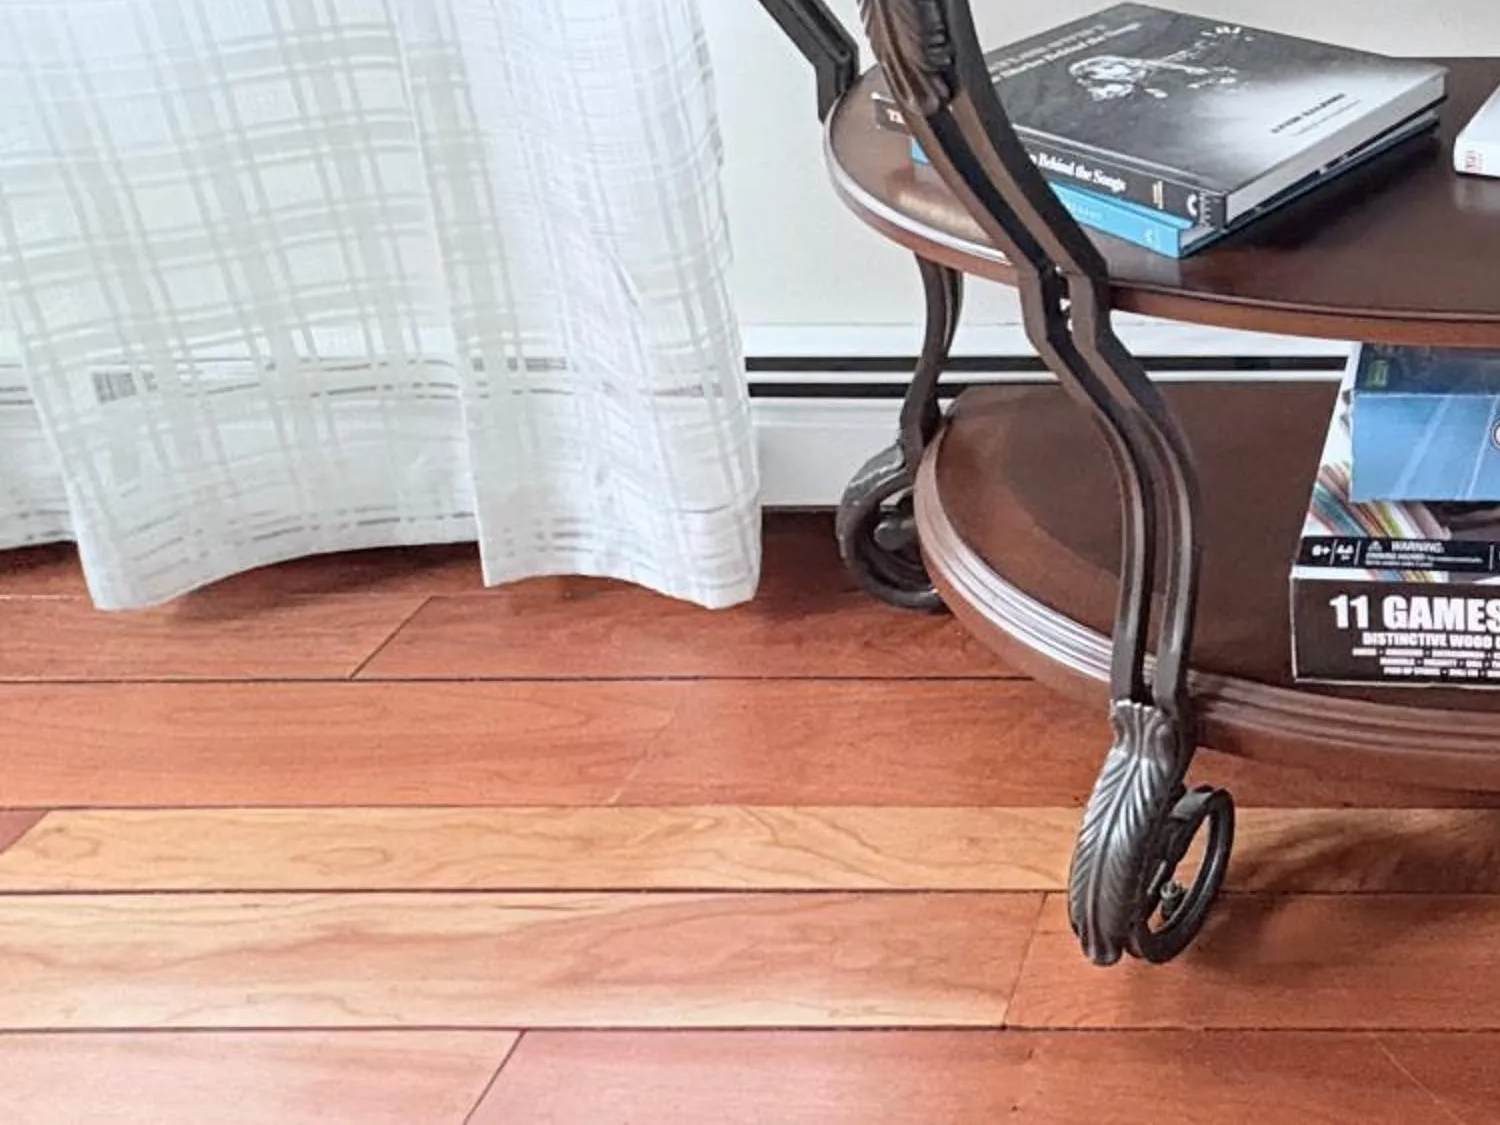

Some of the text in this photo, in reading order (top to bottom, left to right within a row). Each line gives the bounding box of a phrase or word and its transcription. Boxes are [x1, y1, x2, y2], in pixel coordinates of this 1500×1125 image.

[1039, 152, 1075, 176] Behind
[1075, 164, 1092, 181] the
[1093, 168, 1127, 193] Songs
[1329, 594, 1369, 629] 11
[1362, 631, 1447, 647] DISTINCTIVE
[1449, 633, 1492, 649] WOOD
